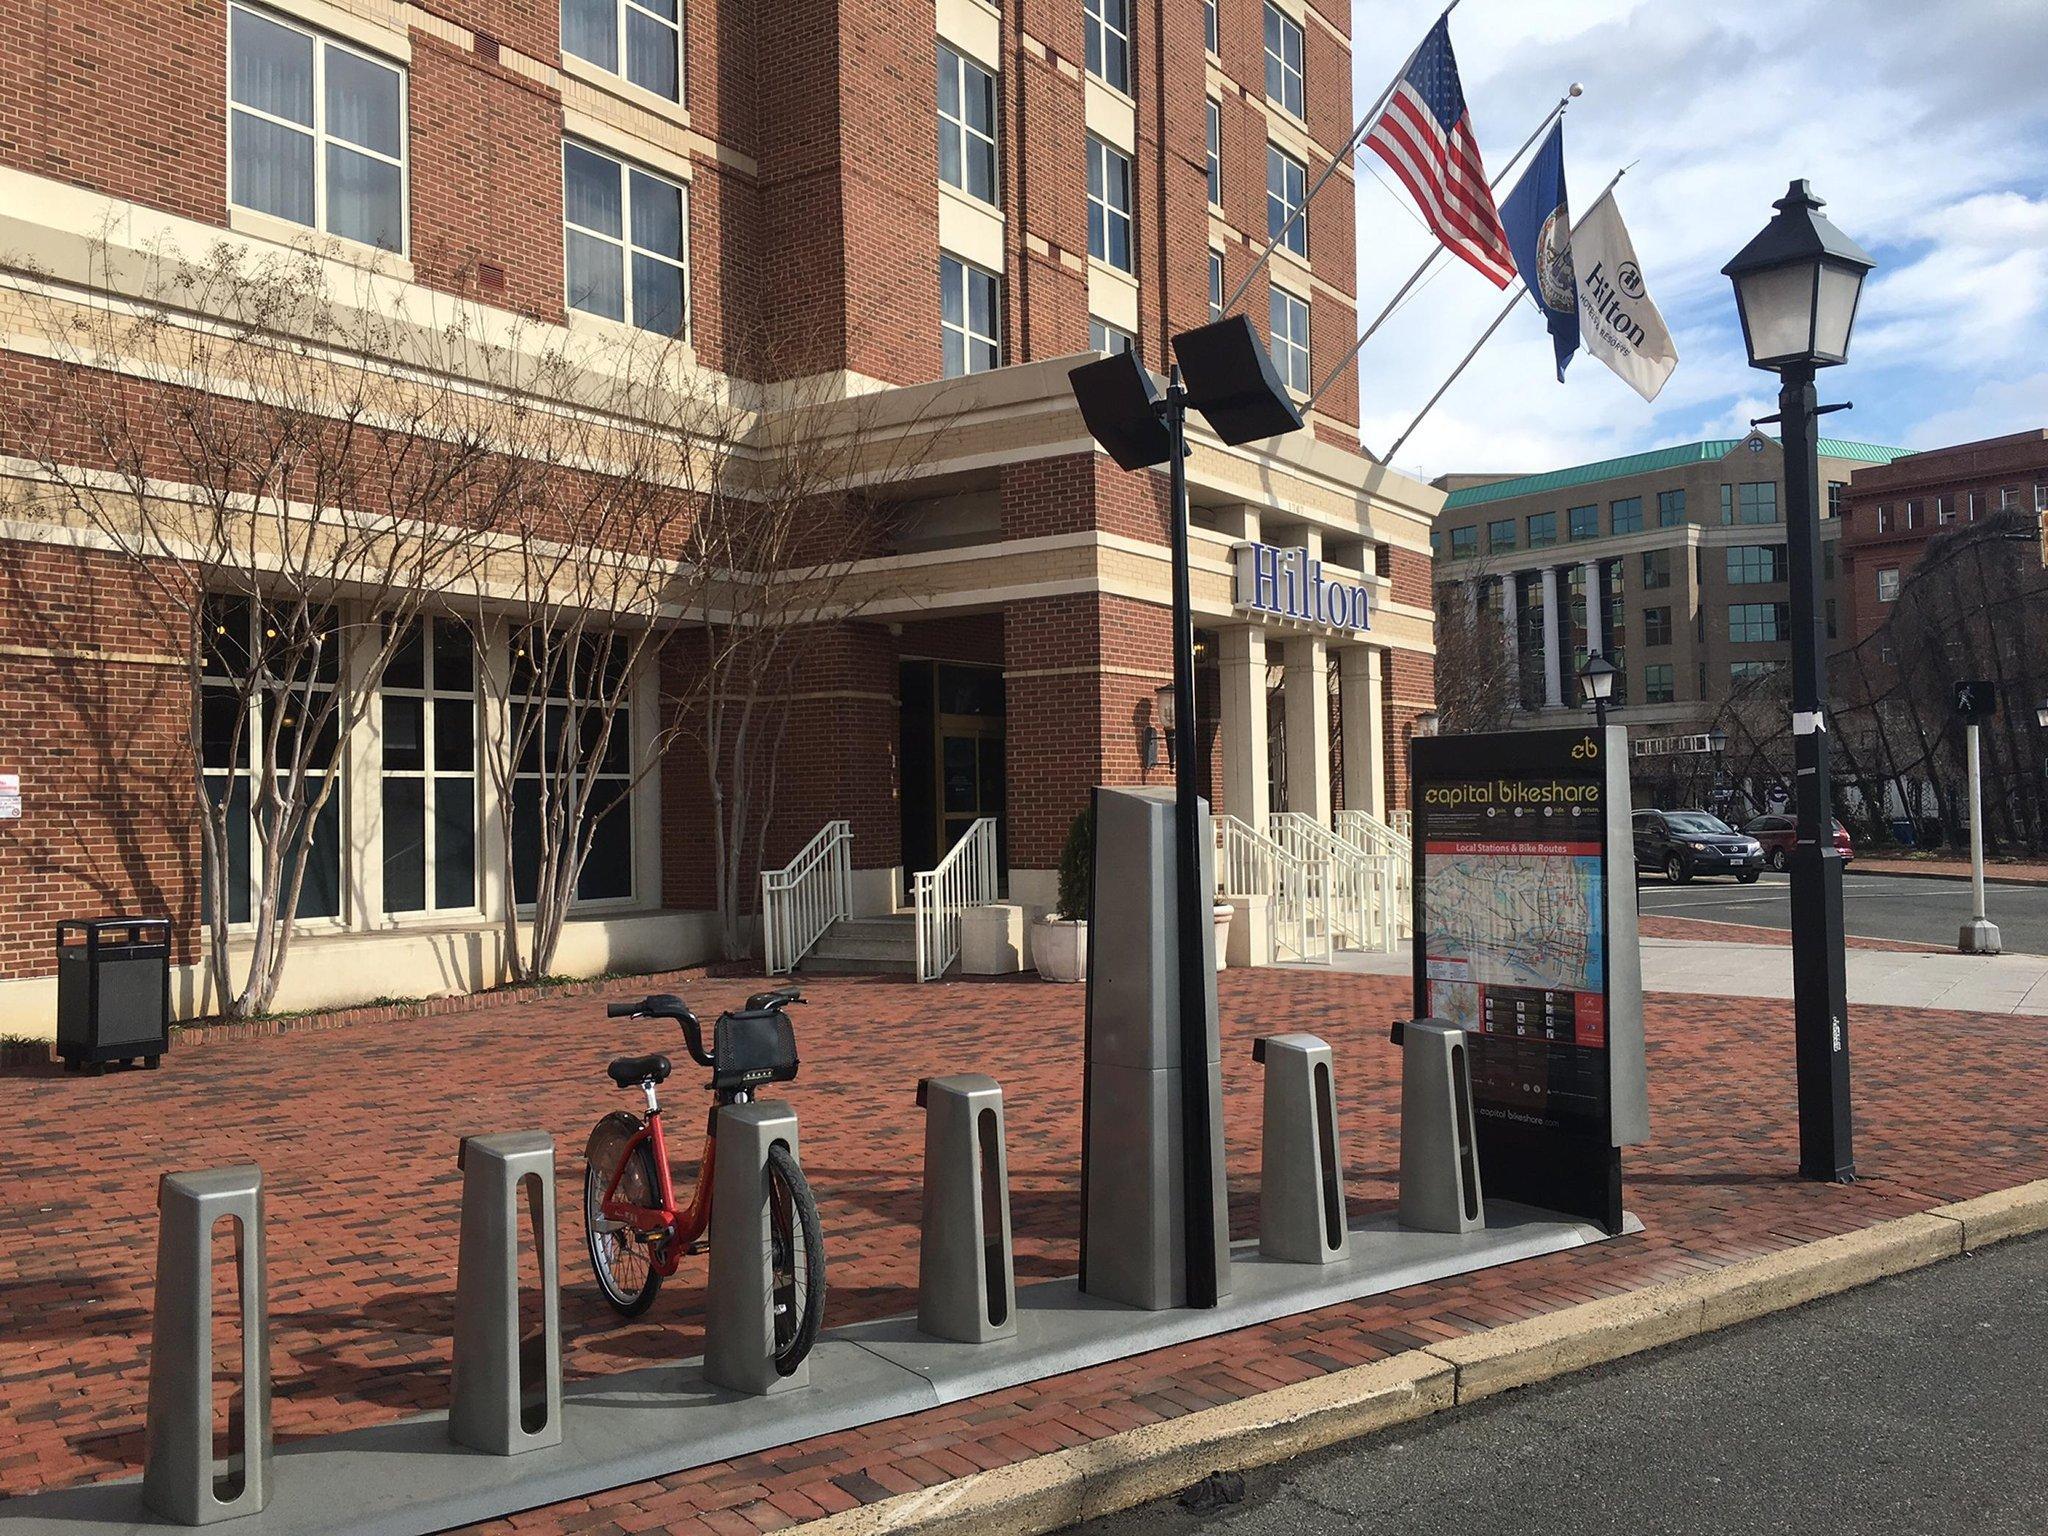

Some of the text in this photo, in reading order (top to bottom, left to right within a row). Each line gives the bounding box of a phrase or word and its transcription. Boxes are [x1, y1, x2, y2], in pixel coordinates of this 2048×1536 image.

[1585, 261, 1646, 348] Hilton
[1599, 329, 1631, 357] RESORTS
[1250, 542, 1372, 632] Hilton
[1424, 780, 1599, 808] capital bikeshare
[1456, 843, 1568, 853] Local Stations & Bike Routes
